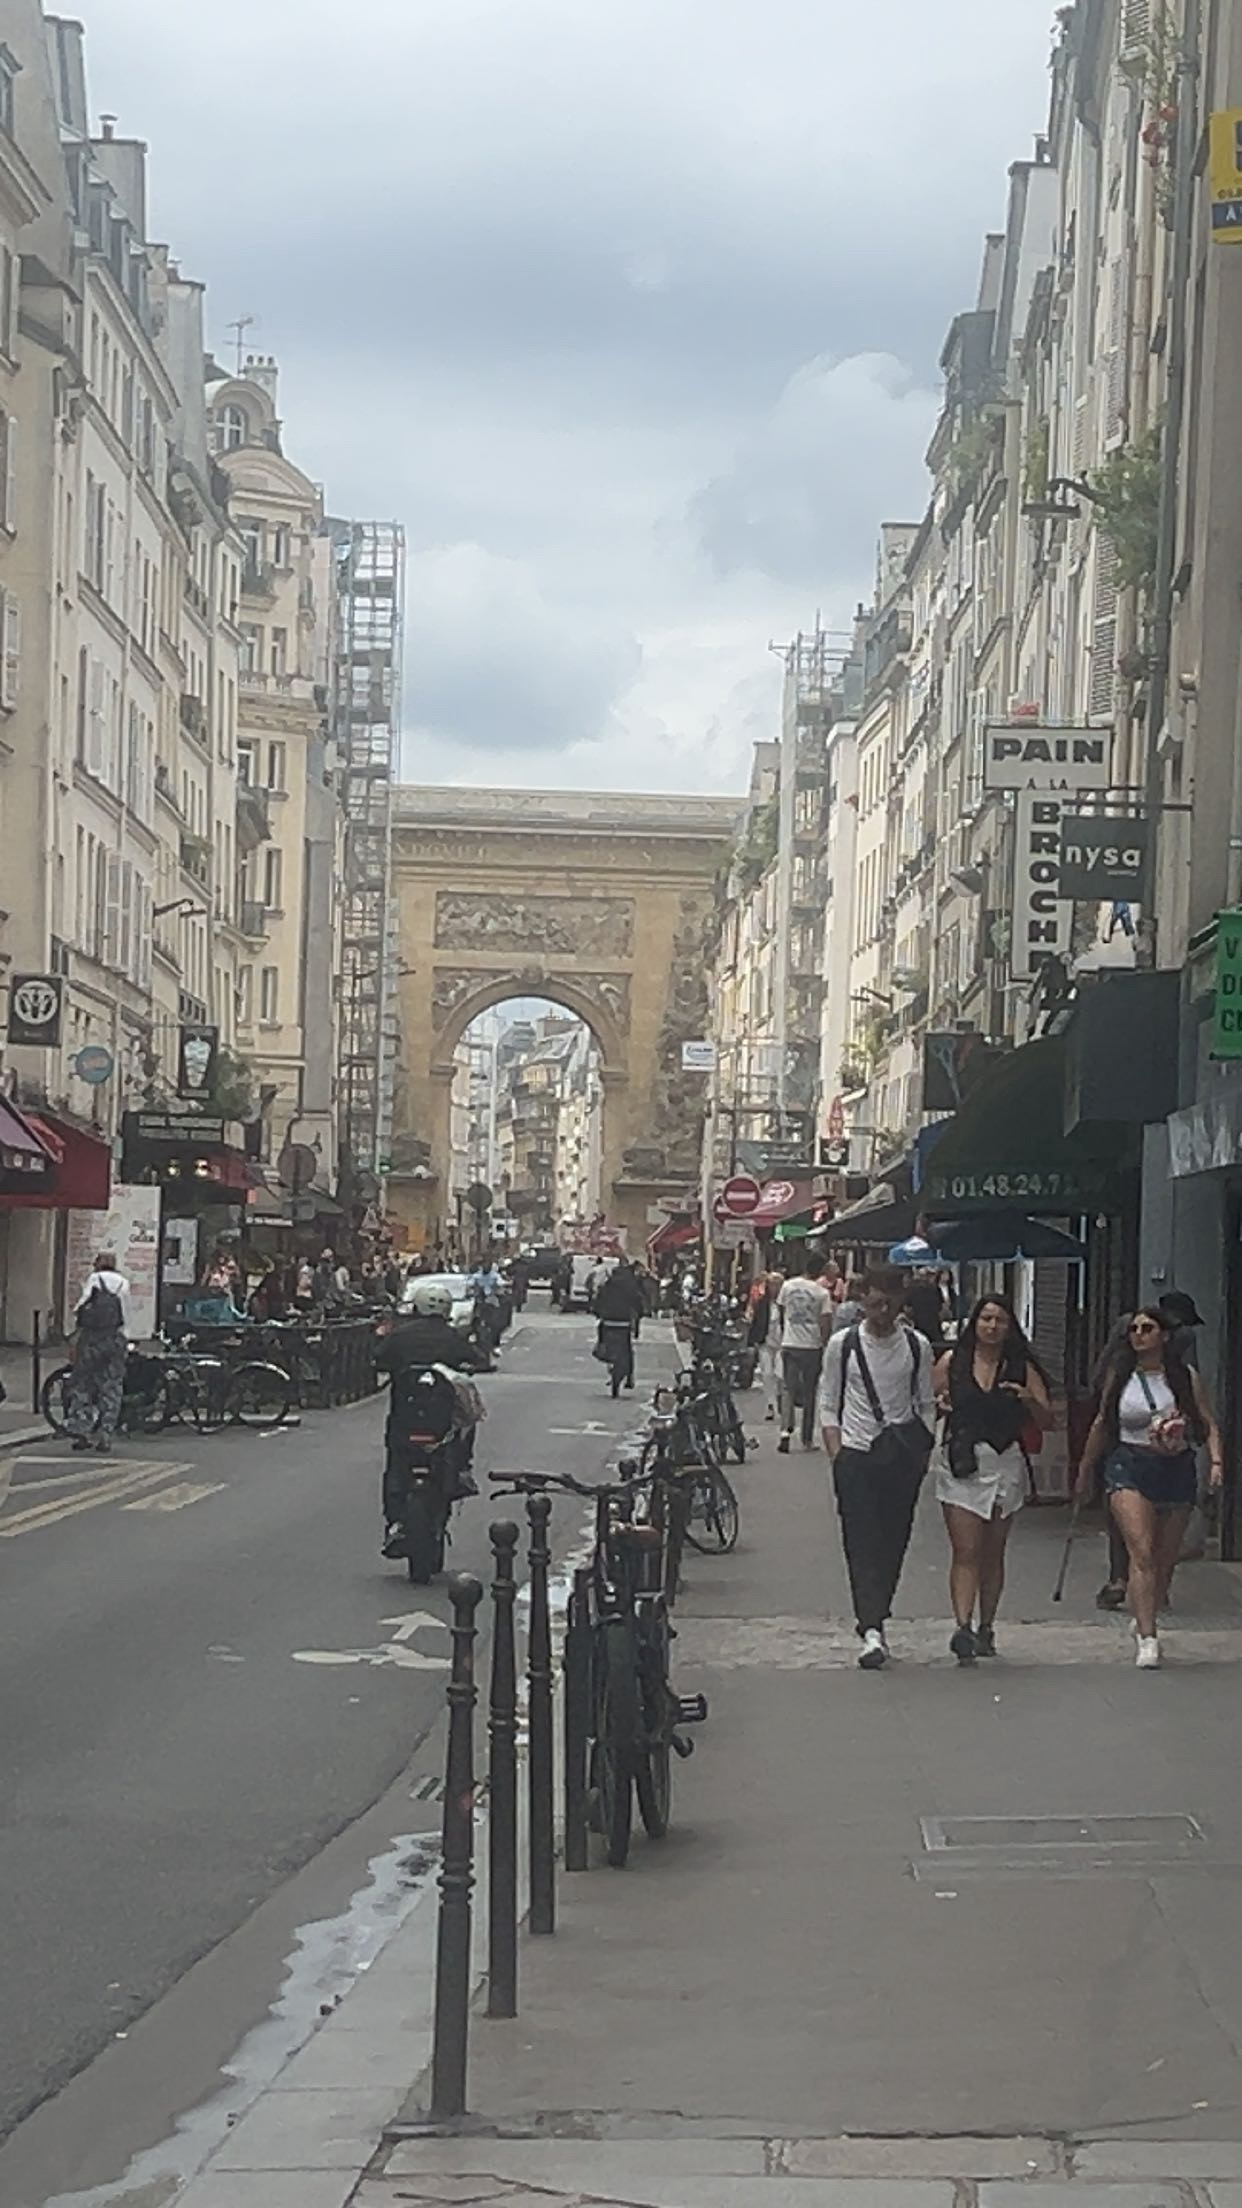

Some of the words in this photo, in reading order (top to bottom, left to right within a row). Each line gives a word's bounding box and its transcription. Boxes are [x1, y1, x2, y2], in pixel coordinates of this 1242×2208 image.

[992, 738, 1103, 764] PAIN
[1050, 778, 1068, 790] LA
[1065, 845, 1141, 872] nysa
